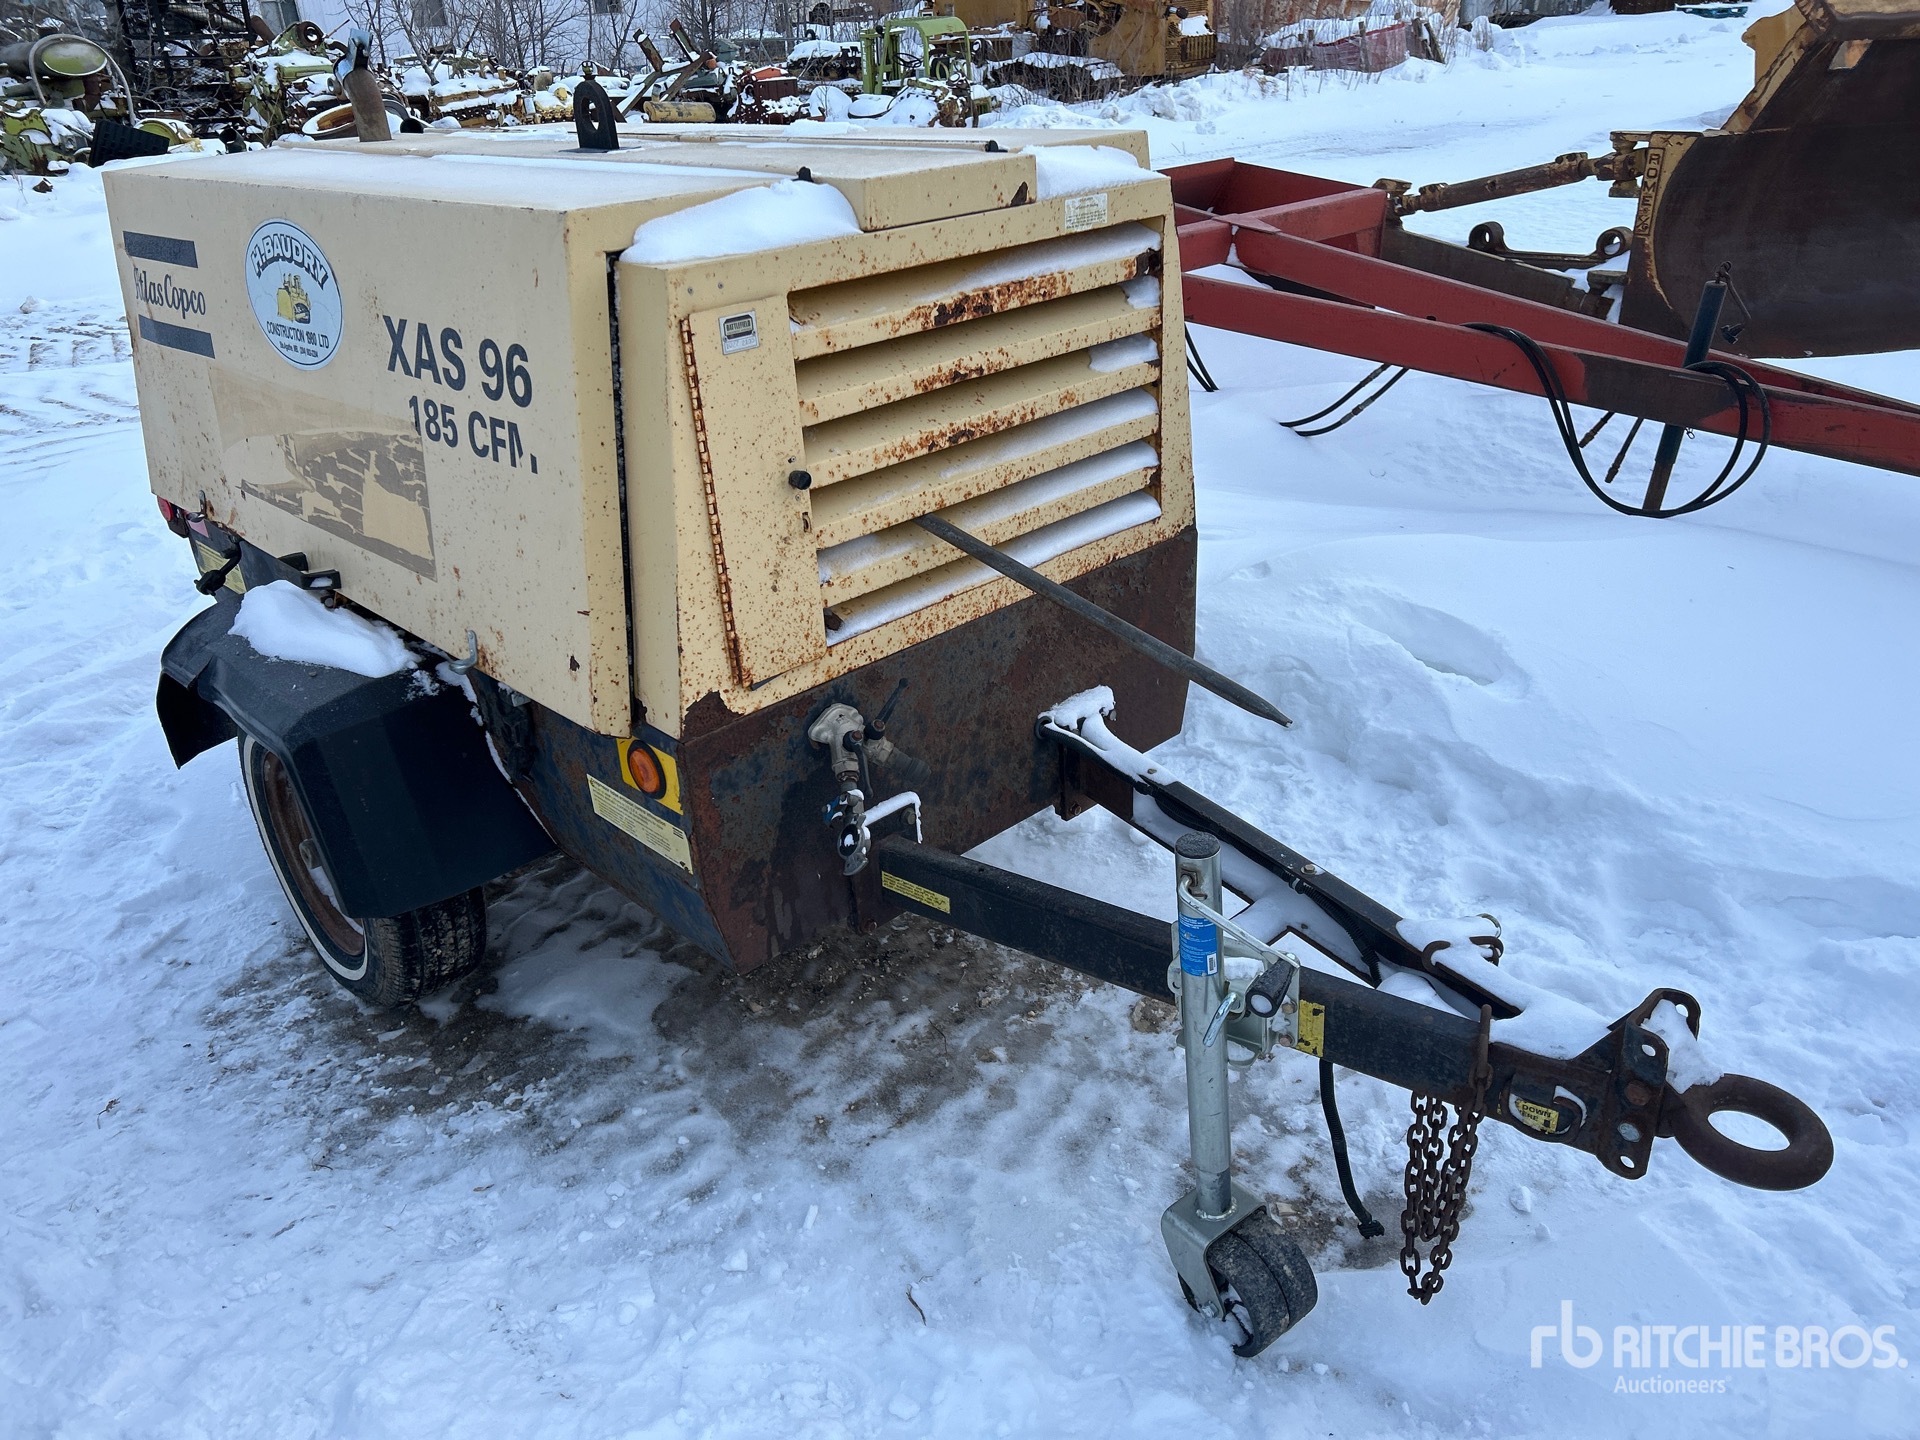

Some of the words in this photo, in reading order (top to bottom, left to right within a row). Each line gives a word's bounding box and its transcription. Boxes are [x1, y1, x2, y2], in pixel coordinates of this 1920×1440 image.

[266, 320, 306, 343] CONSTRUCTION
[318, 333, 330, 349] LTD
[382, 314, 466, 391] XAS
[478, 338, 533, 408] 96
[408, 395, 459, 448] 185
[1522, 1104, 1551, 1118] DOWN
